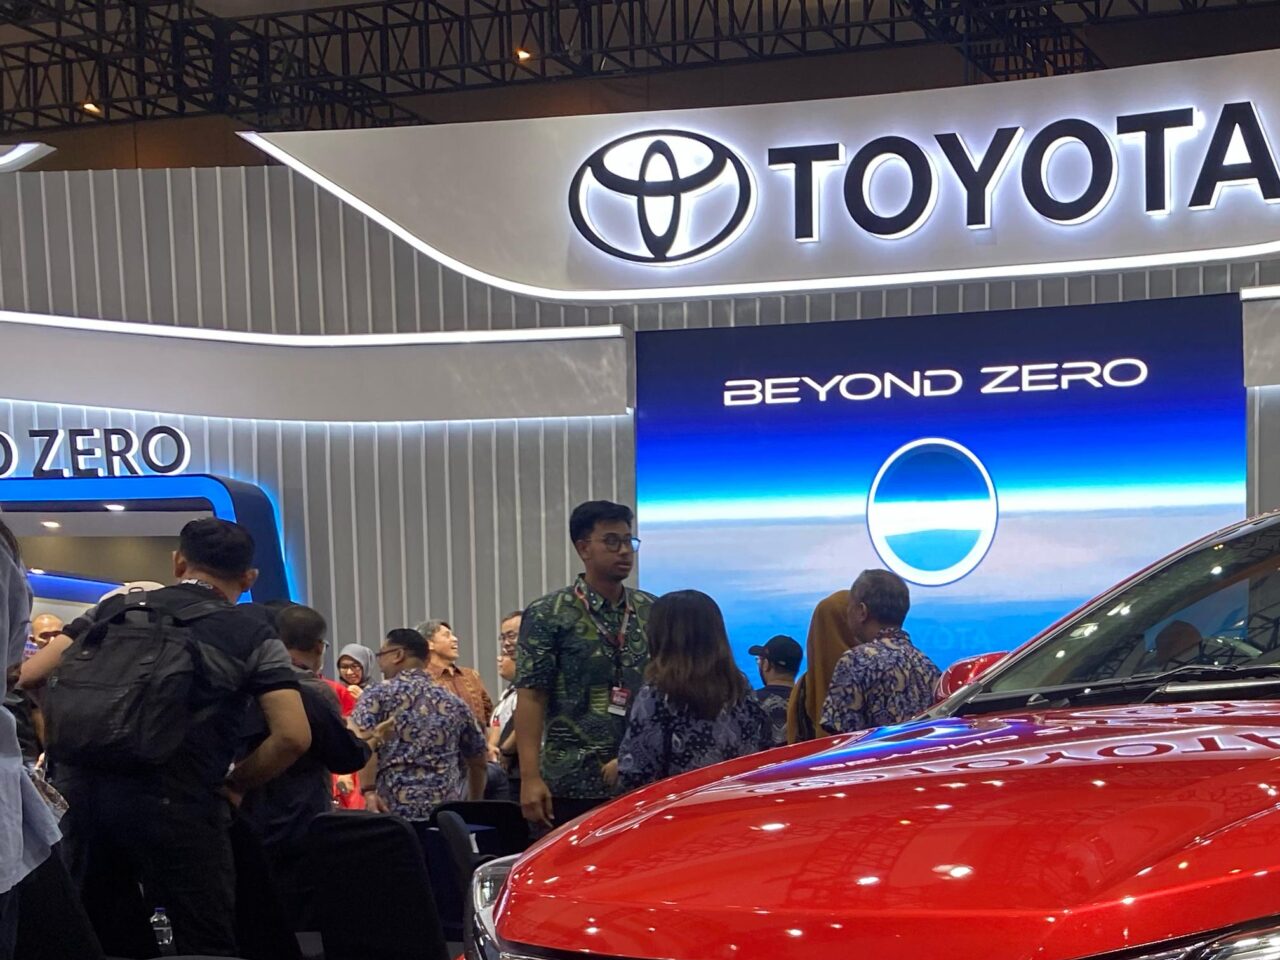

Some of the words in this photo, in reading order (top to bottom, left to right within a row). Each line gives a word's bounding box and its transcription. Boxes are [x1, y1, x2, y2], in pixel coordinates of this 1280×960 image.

[723, 369, 963, 407] BEYOND
[979, 357, 1149, 394] ZERO
[28, 425, 191, 478] ZERO
